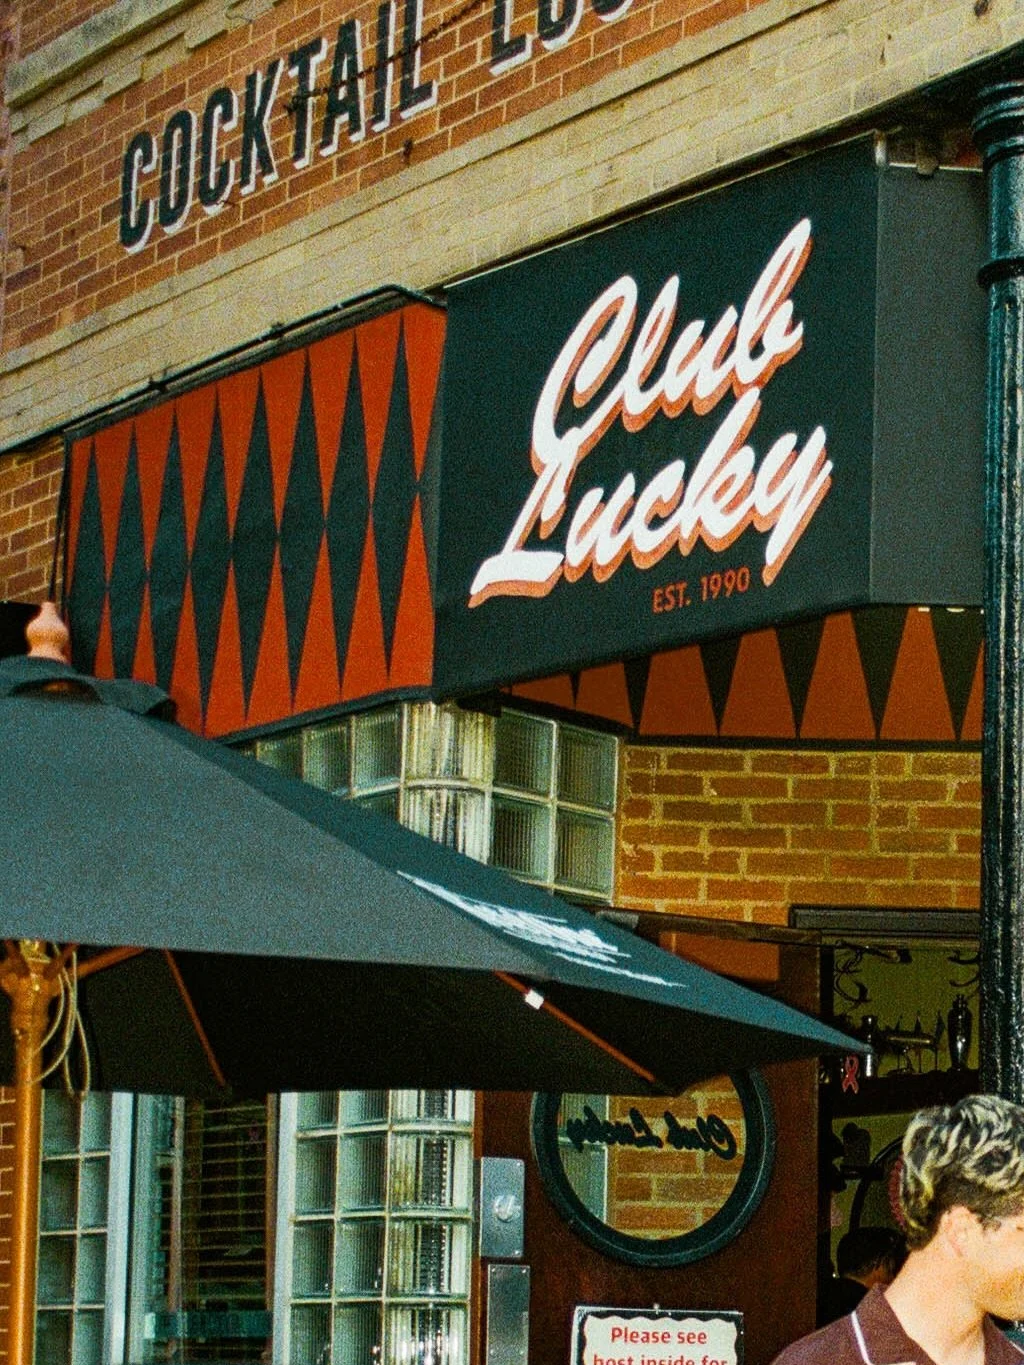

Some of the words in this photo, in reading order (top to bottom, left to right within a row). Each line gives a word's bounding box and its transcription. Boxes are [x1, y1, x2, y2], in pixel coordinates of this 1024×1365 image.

[119, 0, 437, 254] COCKTAIL
[531, 218, 813, 478] Club
[468, 388, 833, 609] Lucky
[651, 581, 692, 613] EST.
[702, 568, 751, 601] 1990
[611, 1327, 671, 1345] Please
[677, 1331, 707, 1345] see
